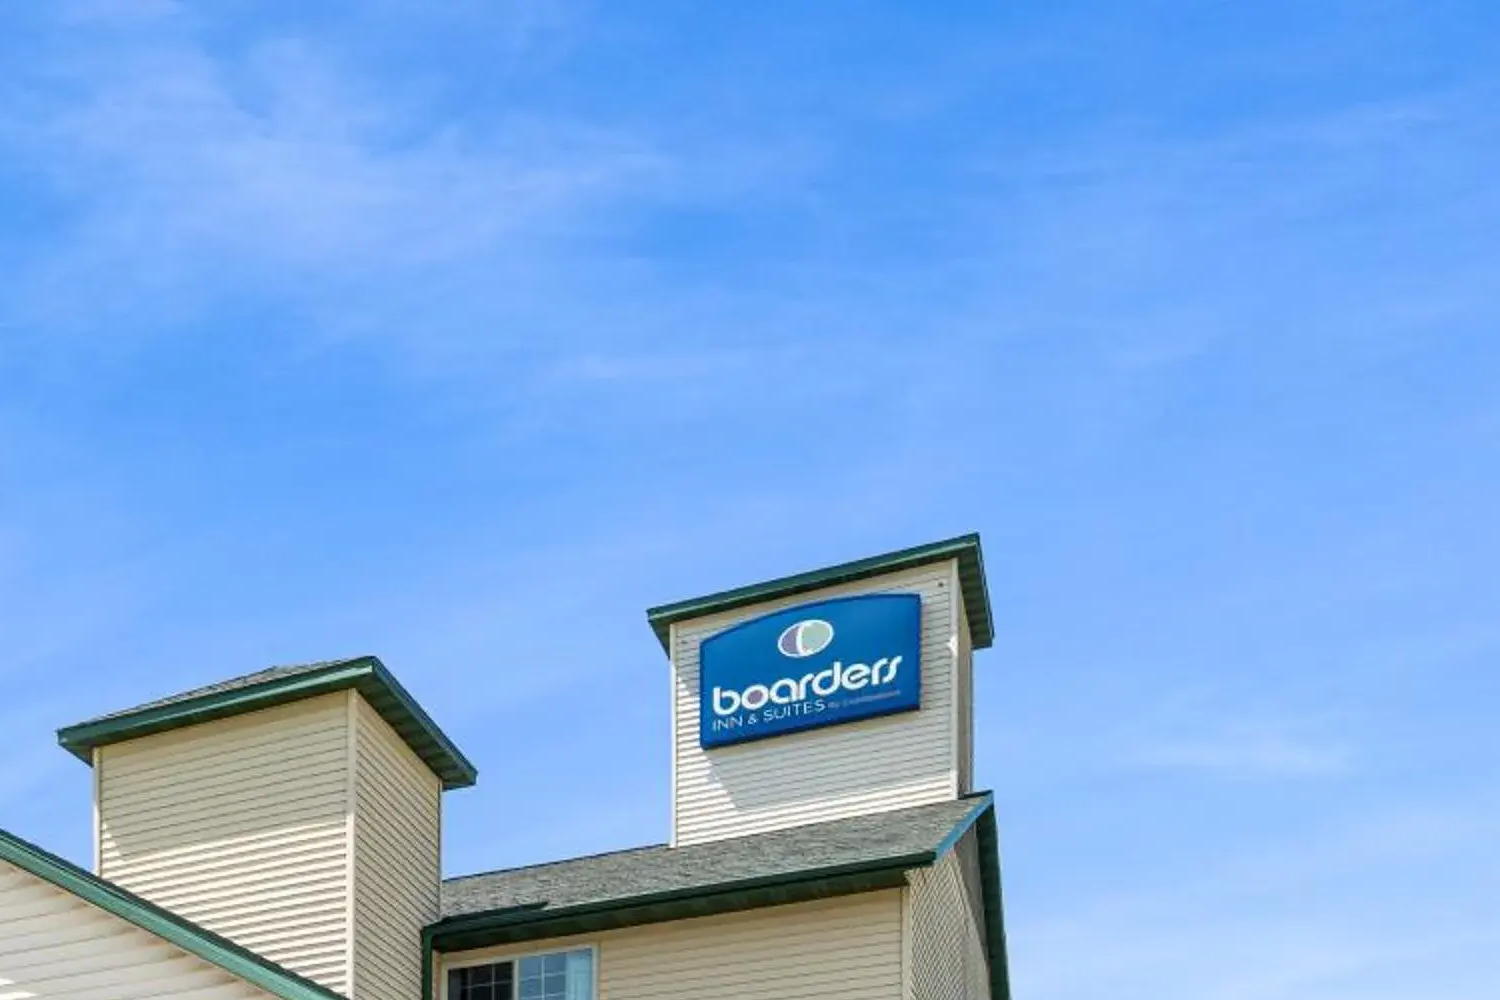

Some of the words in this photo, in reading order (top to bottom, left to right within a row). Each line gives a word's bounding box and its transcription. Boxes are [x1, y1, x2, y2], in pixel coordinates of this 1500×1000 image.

[712, 656, 903, 715] boarders
[712, 714, 743, 733] INN
[747, 710, 758, 725] &
[763, 699, 827, 722] SUITES
